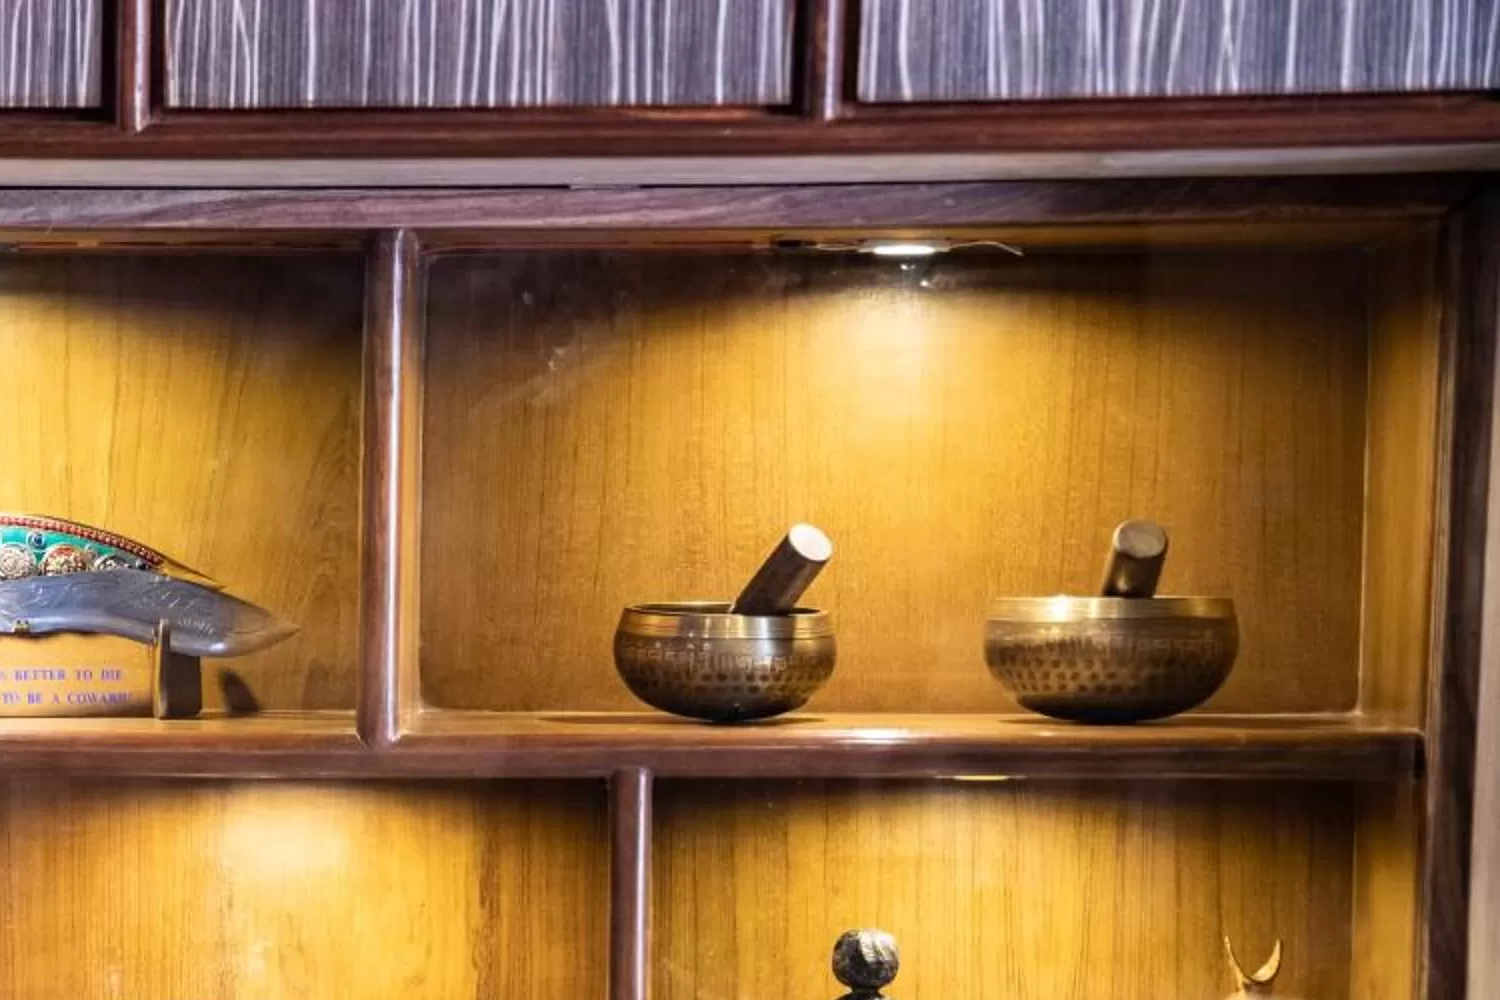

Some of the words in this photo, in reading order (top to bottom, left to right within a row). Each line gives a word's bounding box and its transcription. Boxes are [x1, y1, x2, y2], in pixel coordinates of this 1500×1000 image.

[14, 668, 66, 681] BETTER
[76, 668, 93, 681] TO
[101, 668, 121, 681] DIE
[3, 691, 20, 705] TO
[27, 691, 42, 705] BE
[51, 692, 60, 705] A
